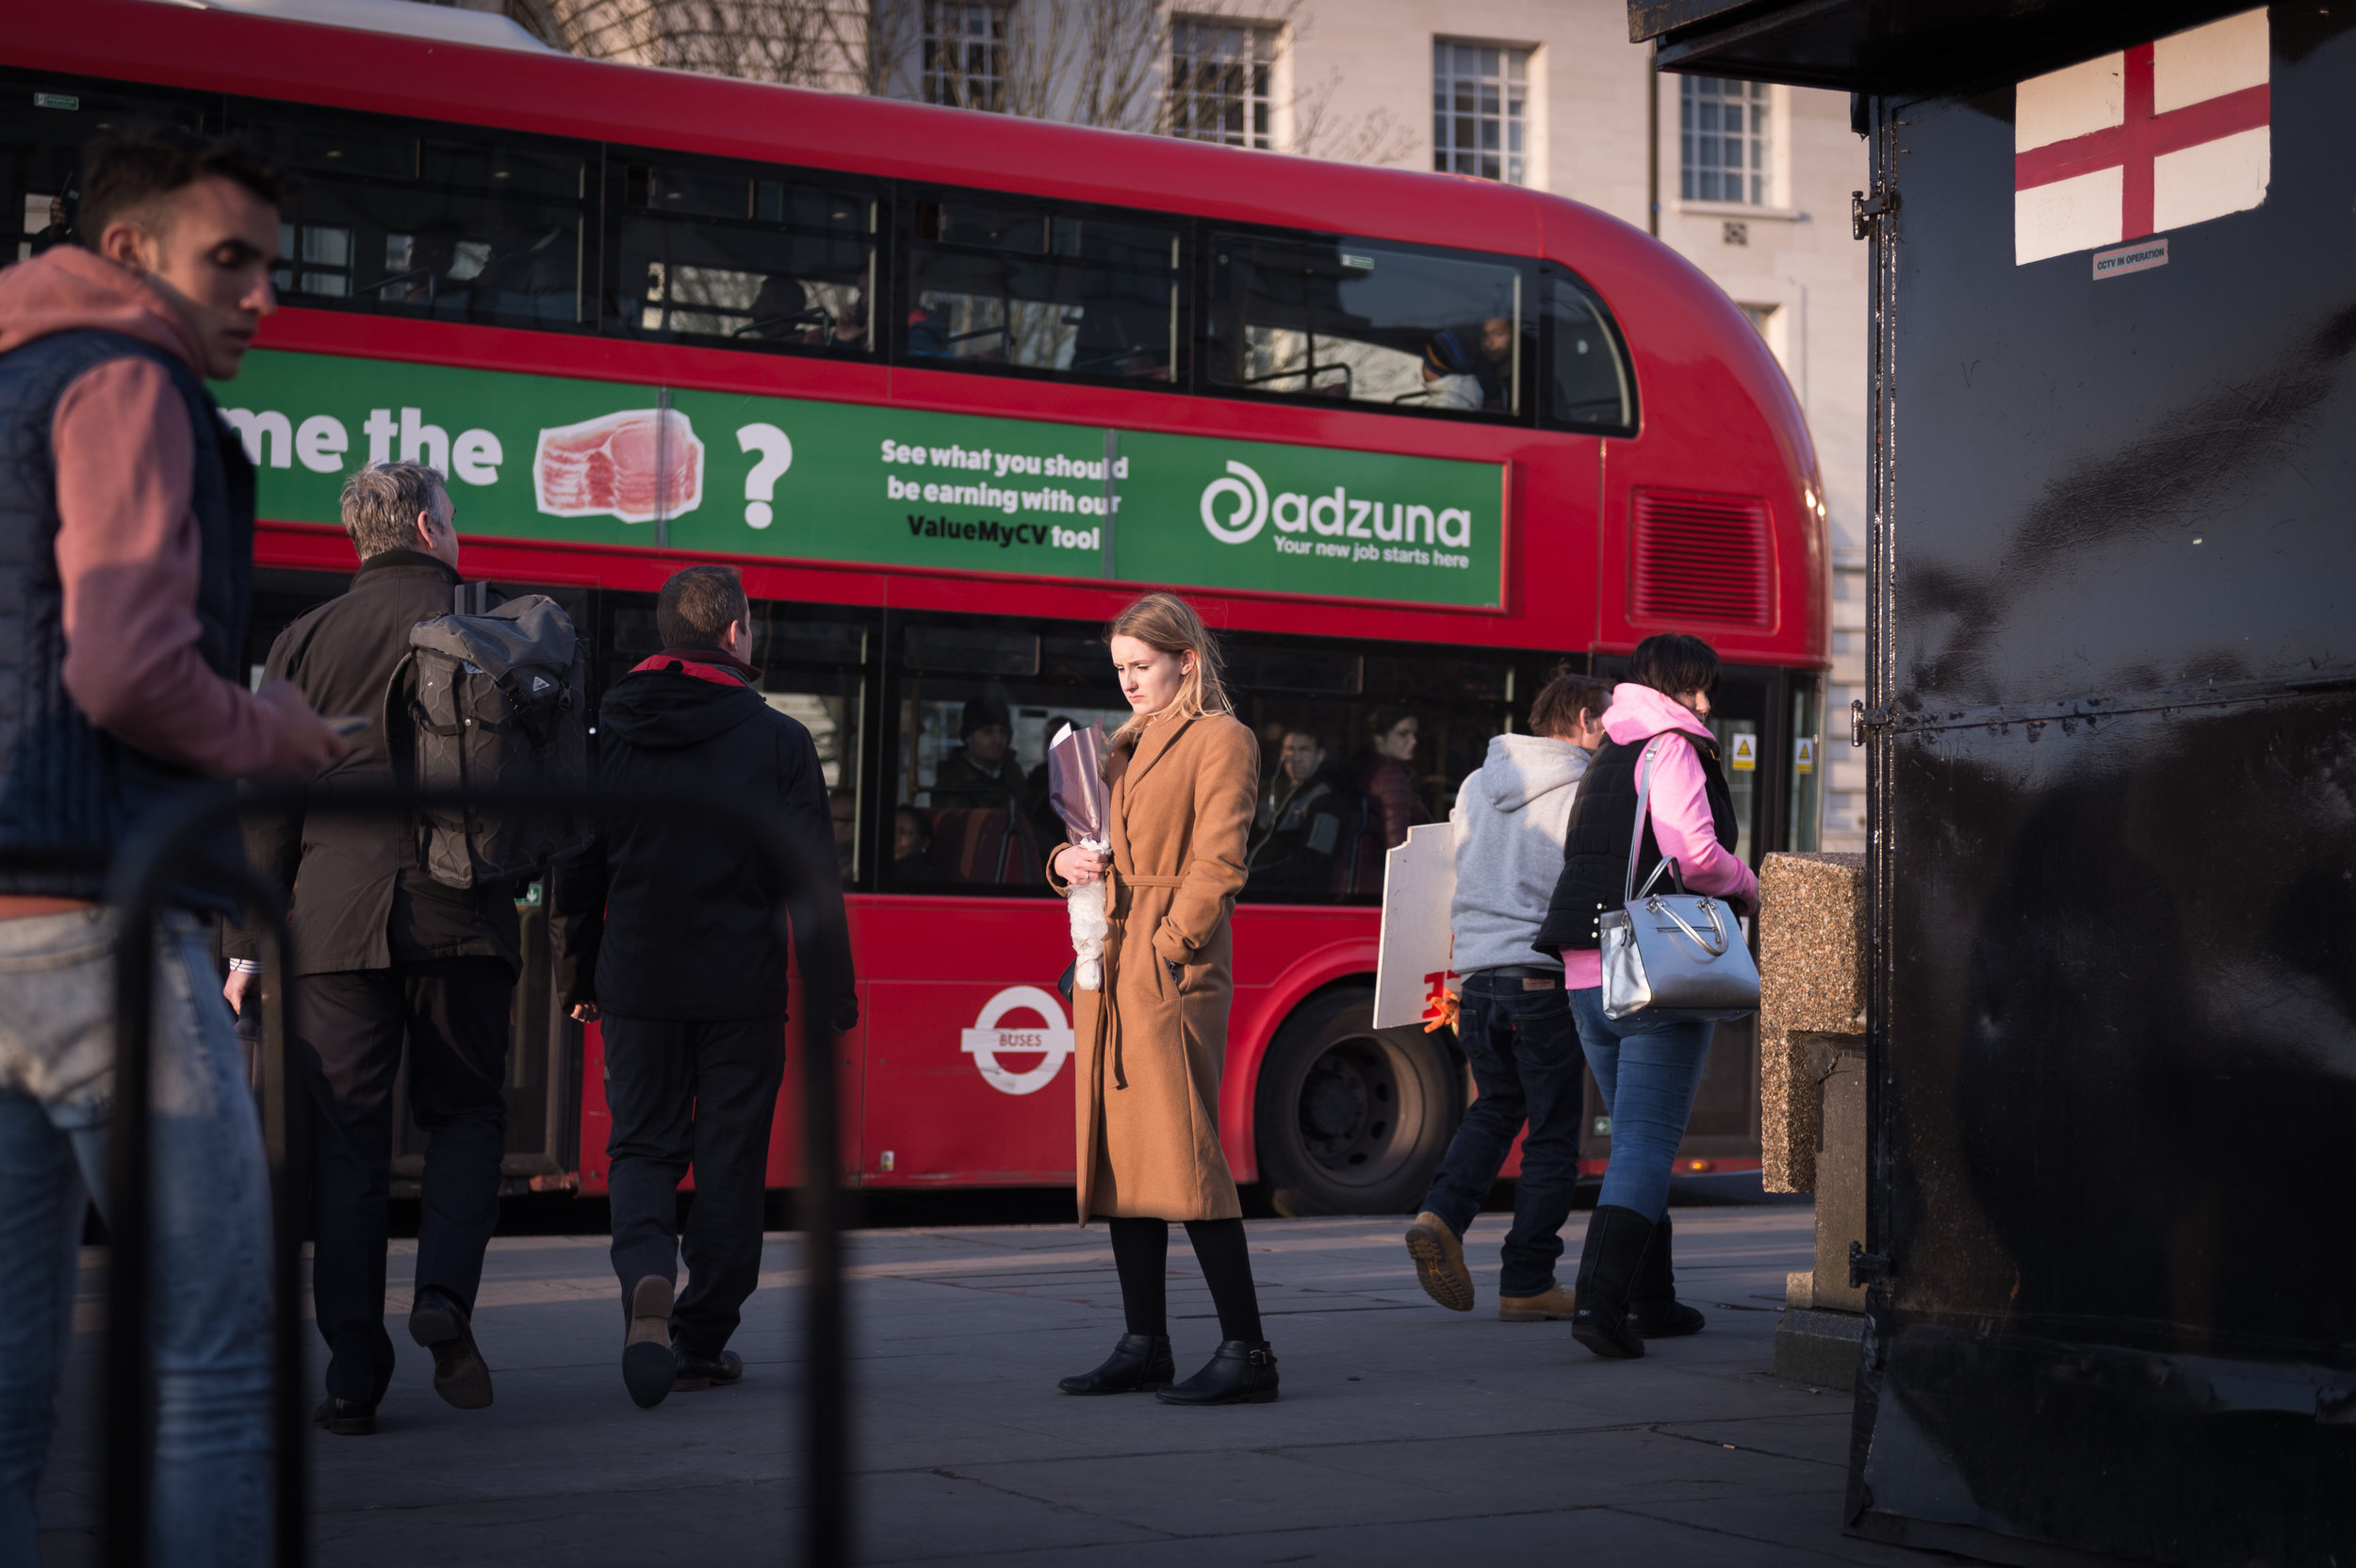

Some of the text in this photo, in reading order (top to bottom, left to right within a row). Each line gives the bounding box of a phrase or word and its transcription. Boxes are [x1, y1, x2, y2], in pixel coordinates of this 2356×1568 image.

[2097, 248, 2165, 270] CCTV IN OPERATION
[217, 406, 793, 530] me the ?
[881, 439, 1129, 481] See what you should
[887, 475, 1121, 515] be earning with our
[908, 514, 1100, 549] ValueMyCV tool
[1272, 486, 1471, 547] adzuna
[1274, 535, 1470, 569] Your new job starts here
[1000, 1034, 1042, 1047] BUSES
